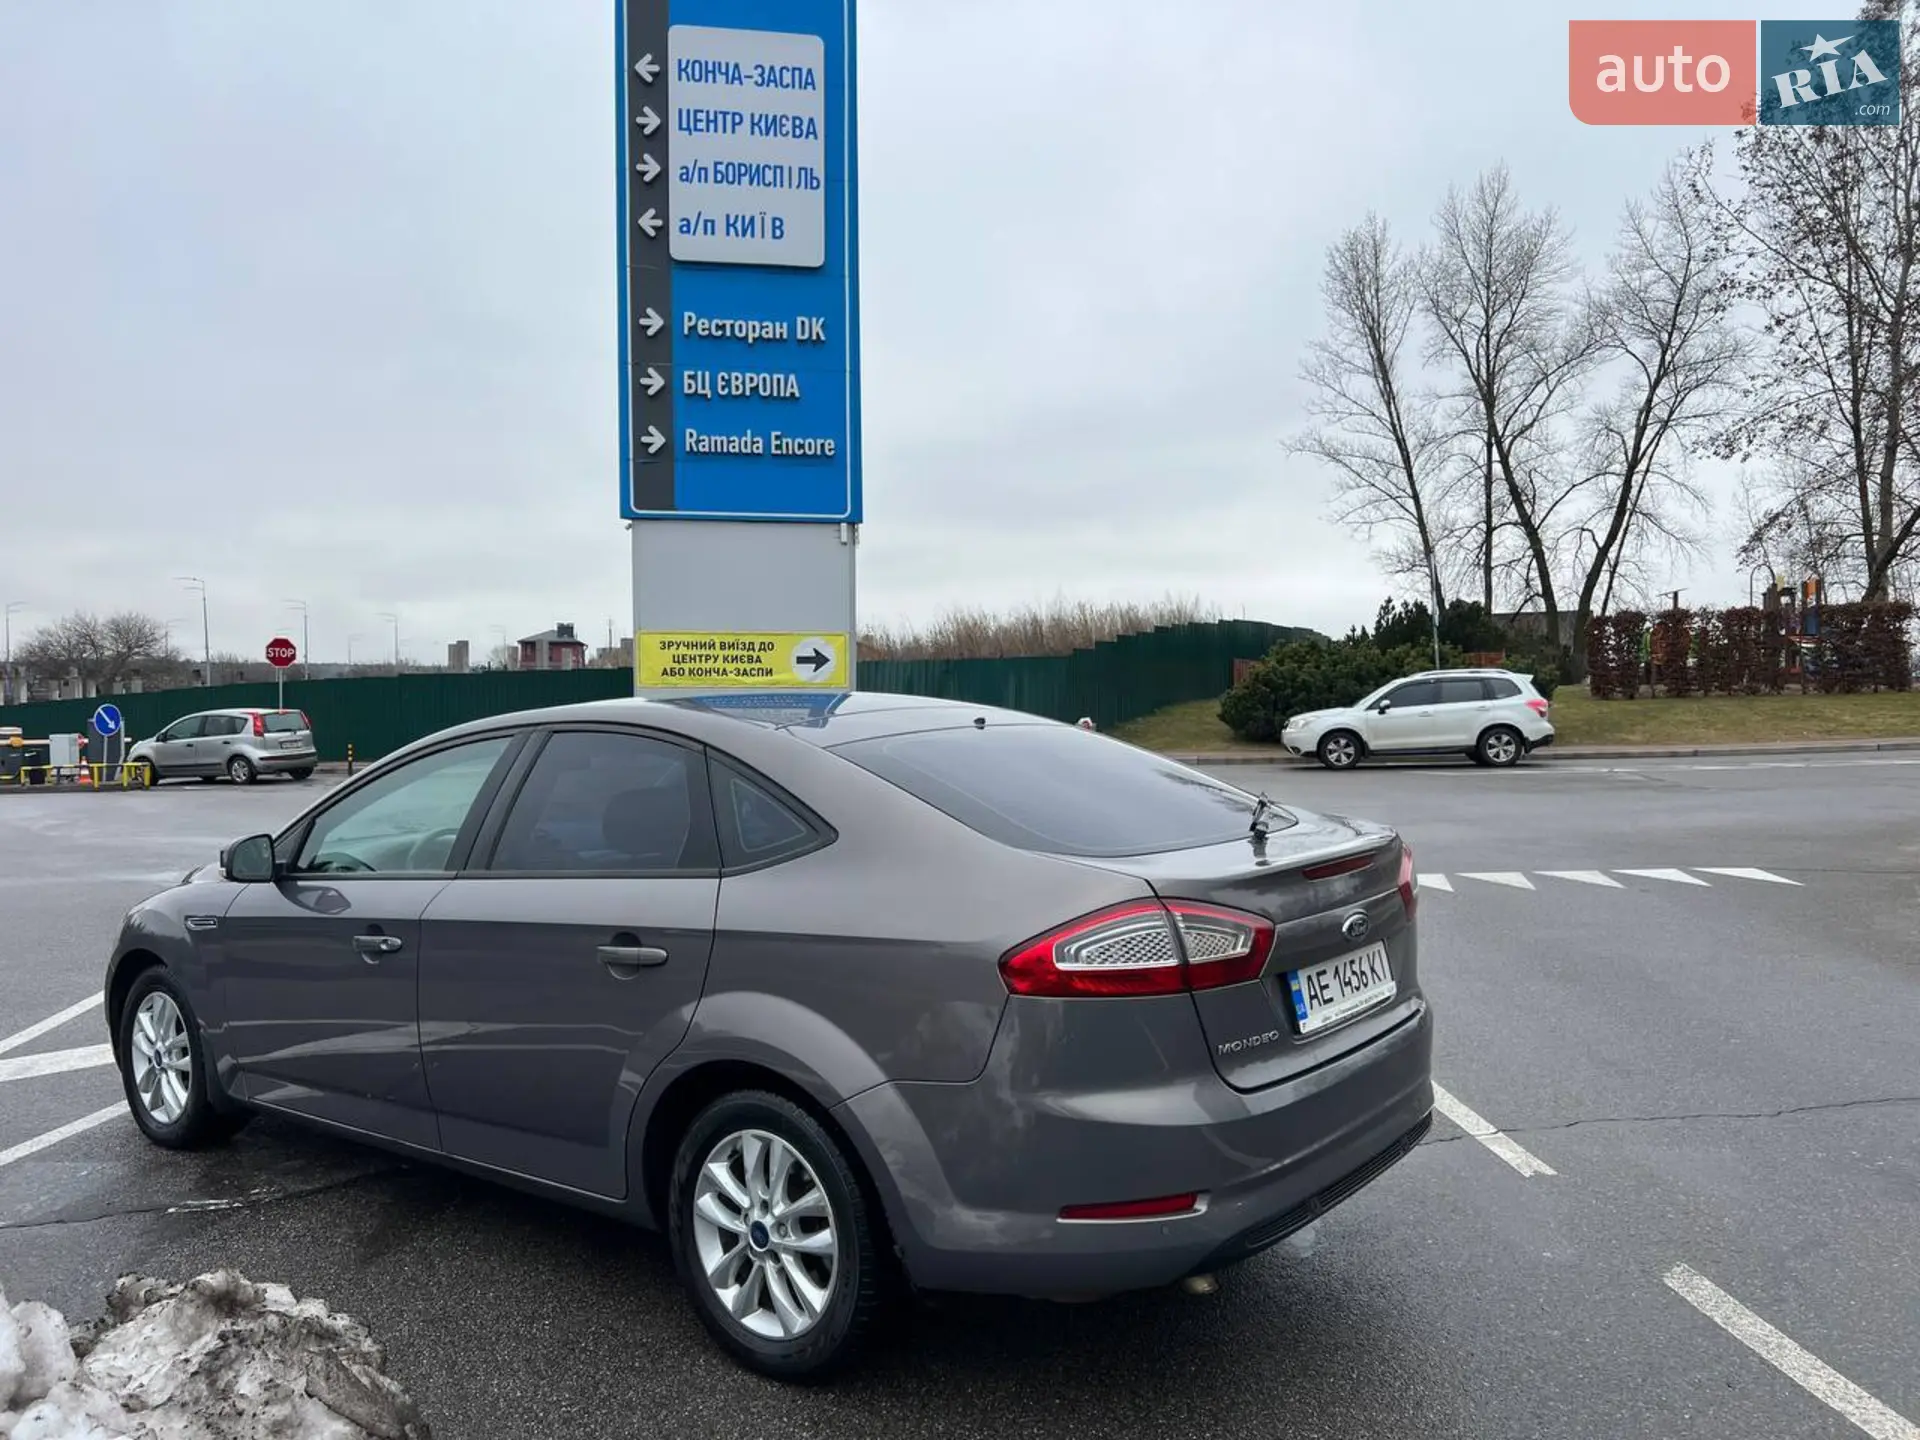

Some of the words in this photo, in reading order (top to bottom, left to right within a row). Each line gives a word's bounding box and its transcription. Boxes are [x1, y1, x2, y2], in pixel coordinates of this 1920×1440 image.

[677, 58, 816, 91] КОНЧА-ЗАСПА
[677, 107, 744, 136] ЦЕНТР
[750, 113, 818, 140] КИЄВА
[678, 159, 709, 184] а/п
[678, 211, 716, 237] а/п
[725, 212, 785, 240] КИЇВ
[683, 311, 788, 343] Ресторан
[796, 316, 826, 341] DK
[683, 371, 711, 398] БЦ
[717, 372, 800, 398] ЄВРОПА
[685, 428, 763, 454] Ramada
[770, 431, 835, 456] Encore
[267, 647, 295, 658] STOP
[659, 639, 717, 651] ЗРУЧНИЙ
[720, 639, 756, 652] ВИЇЗД
[758, 641, 775, 652] ДО
[661, 667, 685, 677] АБО
[688, 667, 773, 677] КОНЧА-ЗАСПИ
[672, 654, 719, 665] ЦЕНТРУ
[723, 654, 762, 664] КИЄВА
[1307, 969, 1334, 1010] AE
[1333, 956, 1369, 998] 1456
[1367, 949, 1387, 984] KI
[1218, 1030, 1280, 1055] MONDEO
